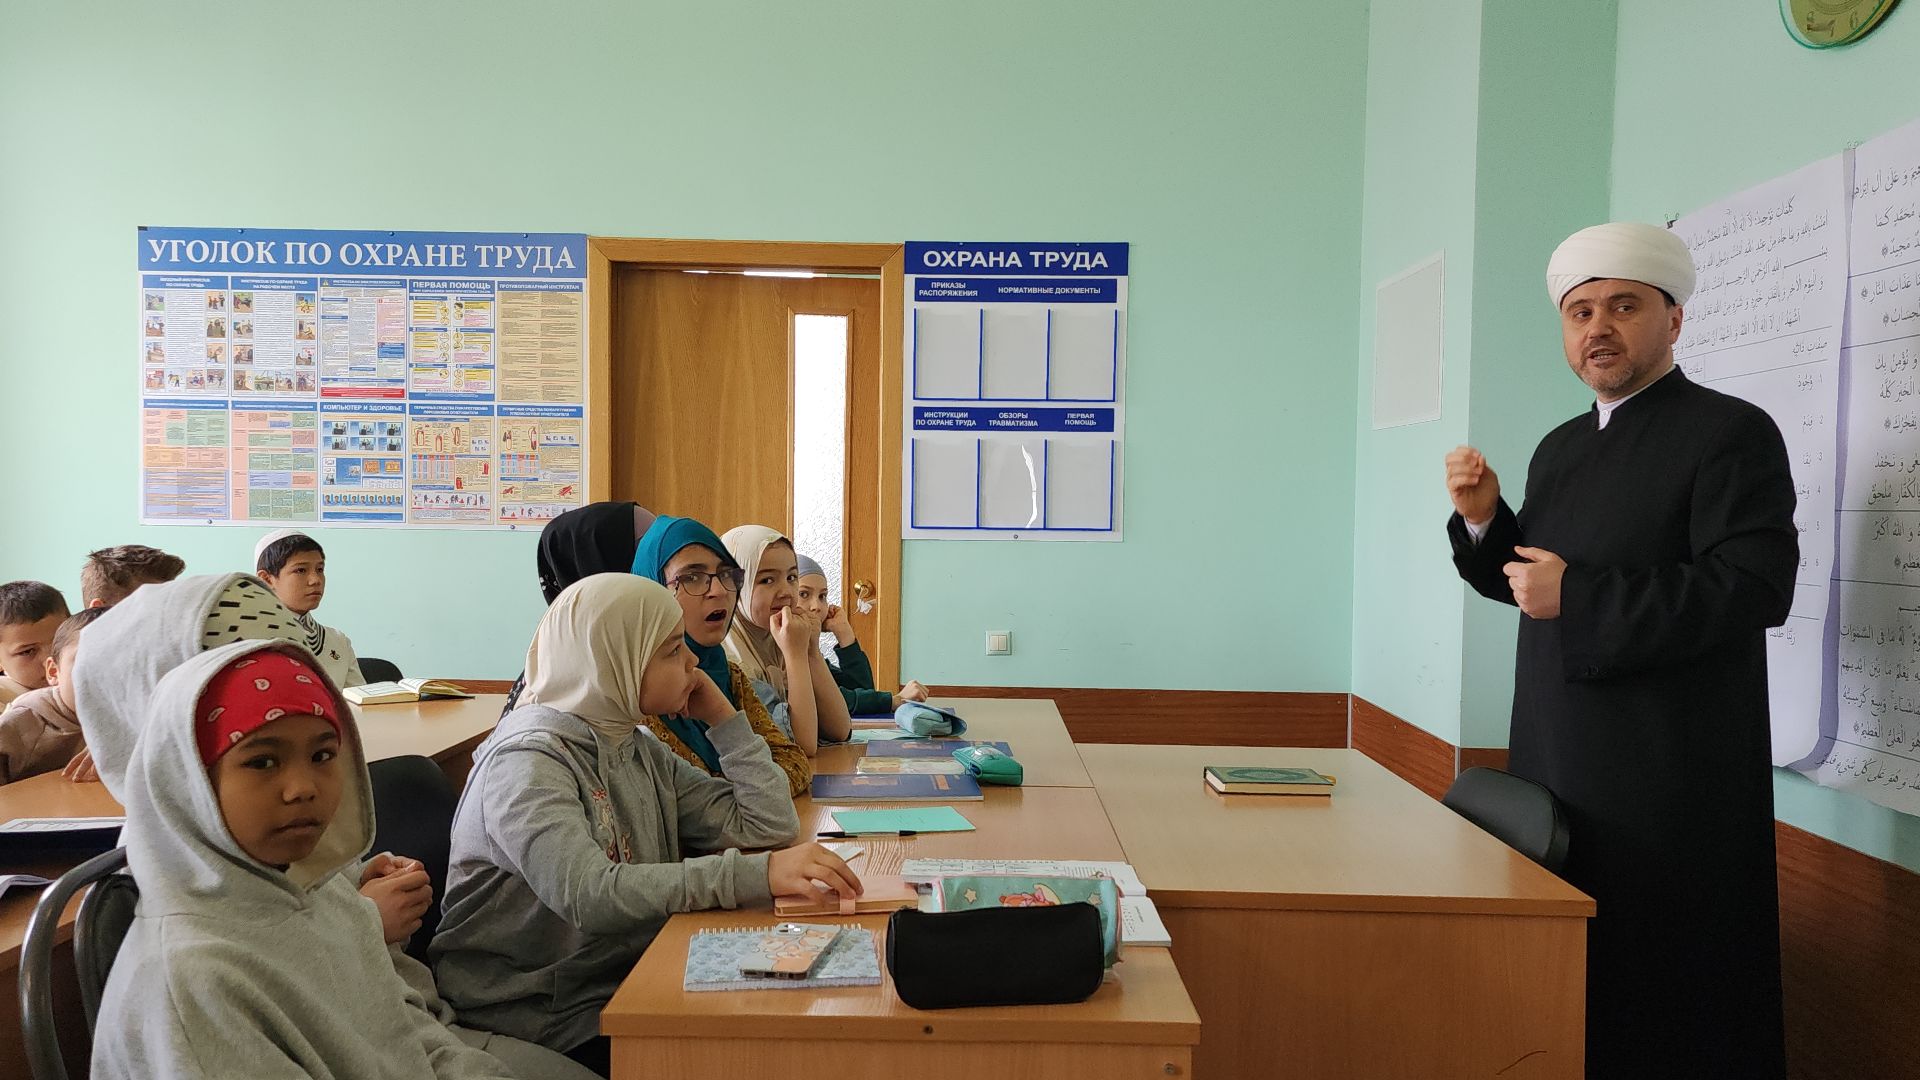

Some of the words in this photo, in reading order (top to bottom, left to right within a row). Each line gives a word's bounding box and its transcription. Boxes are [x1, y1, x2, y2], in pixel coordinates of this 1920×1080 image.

[147, 238, 276, 265] УГОЛОК
[283, 241, 331, 266] ПО
[339, 241, 468, 268] ОХРАНЕ
[475, 244, 576, 274] ТРУДА
[923, 250, 1023, 268] ОХРАНА
[1029, 251, 1109, 271] ТРУДА
[412, 281, 447, 289] ПЕРВАЯ
[449, 282, 491, 290] ПОМОЩЬ
[931, 281, 966, 289] ПРИКАЗЫ
[919, 289, 978, 297] РАСПОРЯЖЕНИЯ
[998, 286, 1053, 294] НОРМАТИВНЫЕ
[1055, 287, 1101, 295] ДОКУМЕНТЫ
[924, 411, 969, 419] ИНСТРУКЦИИ
[998, 412, 1028, 420] ОБЗОРЫ
[1067, 412, 1095, 420] ПЕРВАЯ
[927, 419, 954, 427] ОХРАНЕ
[955, 419, 977, 427] ТРУДА
[989, 419, 1039, 428] ТРАВМАТИЗМА
[1064, 419, 1097, 427] ПОМОЩЬ
